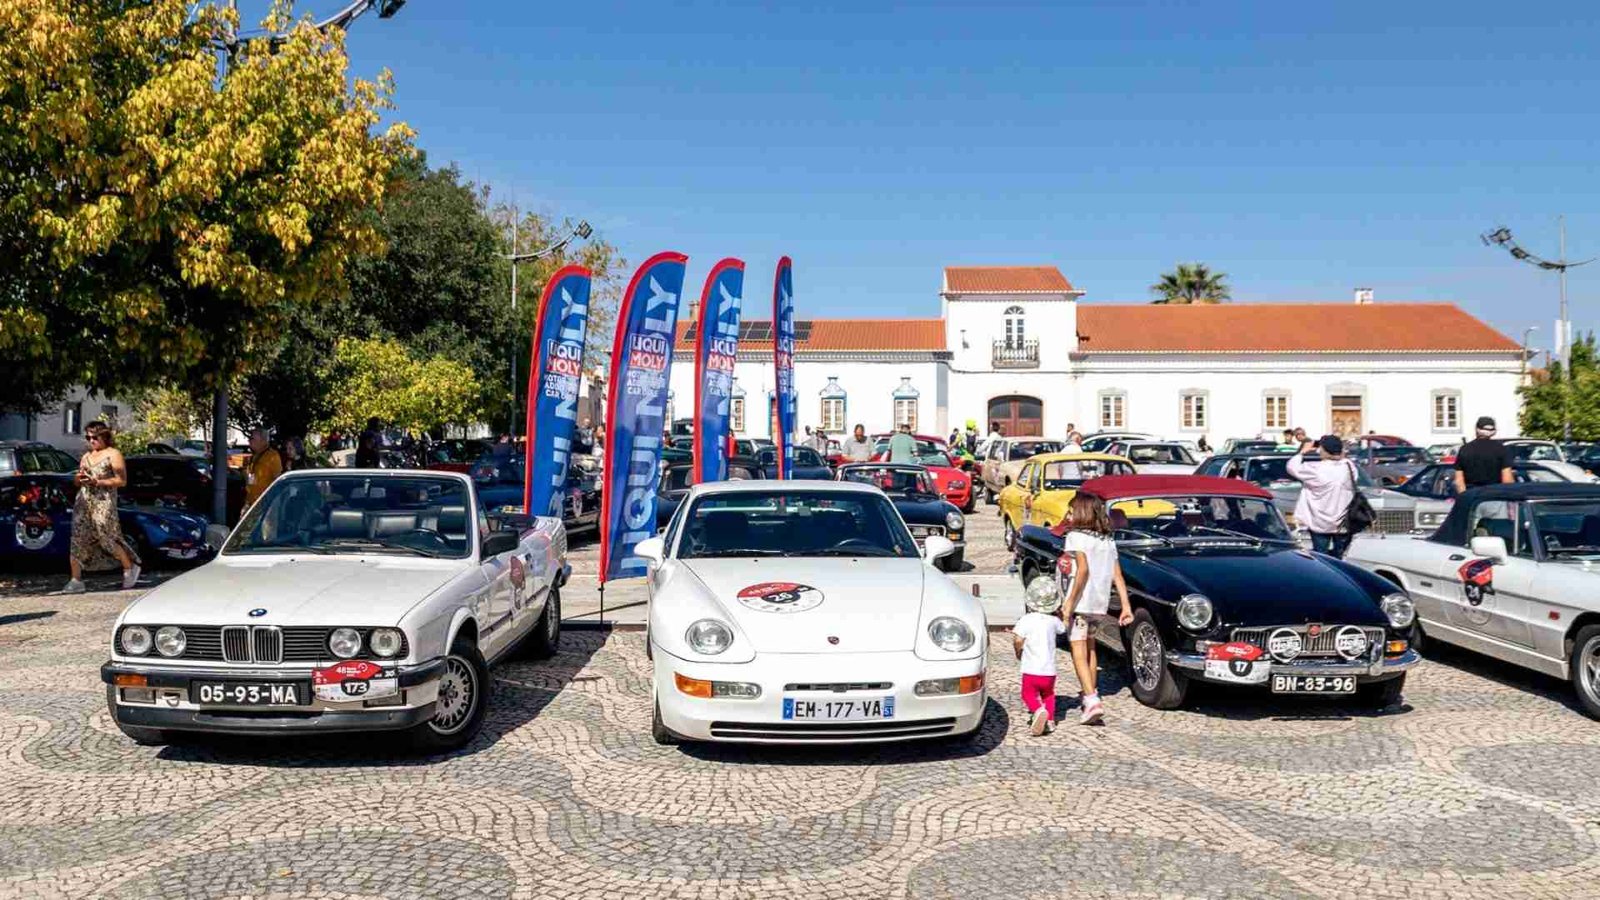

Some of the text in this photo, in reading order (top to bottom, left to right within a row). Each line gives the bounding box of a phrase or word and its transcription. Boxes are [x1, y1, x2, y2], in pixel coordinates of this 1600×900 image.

[632, 335, 666, 355] LIQUI
[630, 351, 665, 369] MOLY
[1234, 660, 1249, 673] 17
[344, 682, 367, 694] 173
[1274, 676, 1354, 692] BN-83-96
[199, 683, 298, 705] 05-93-MA
[795, 700, 882, 718] EM-177-VA
